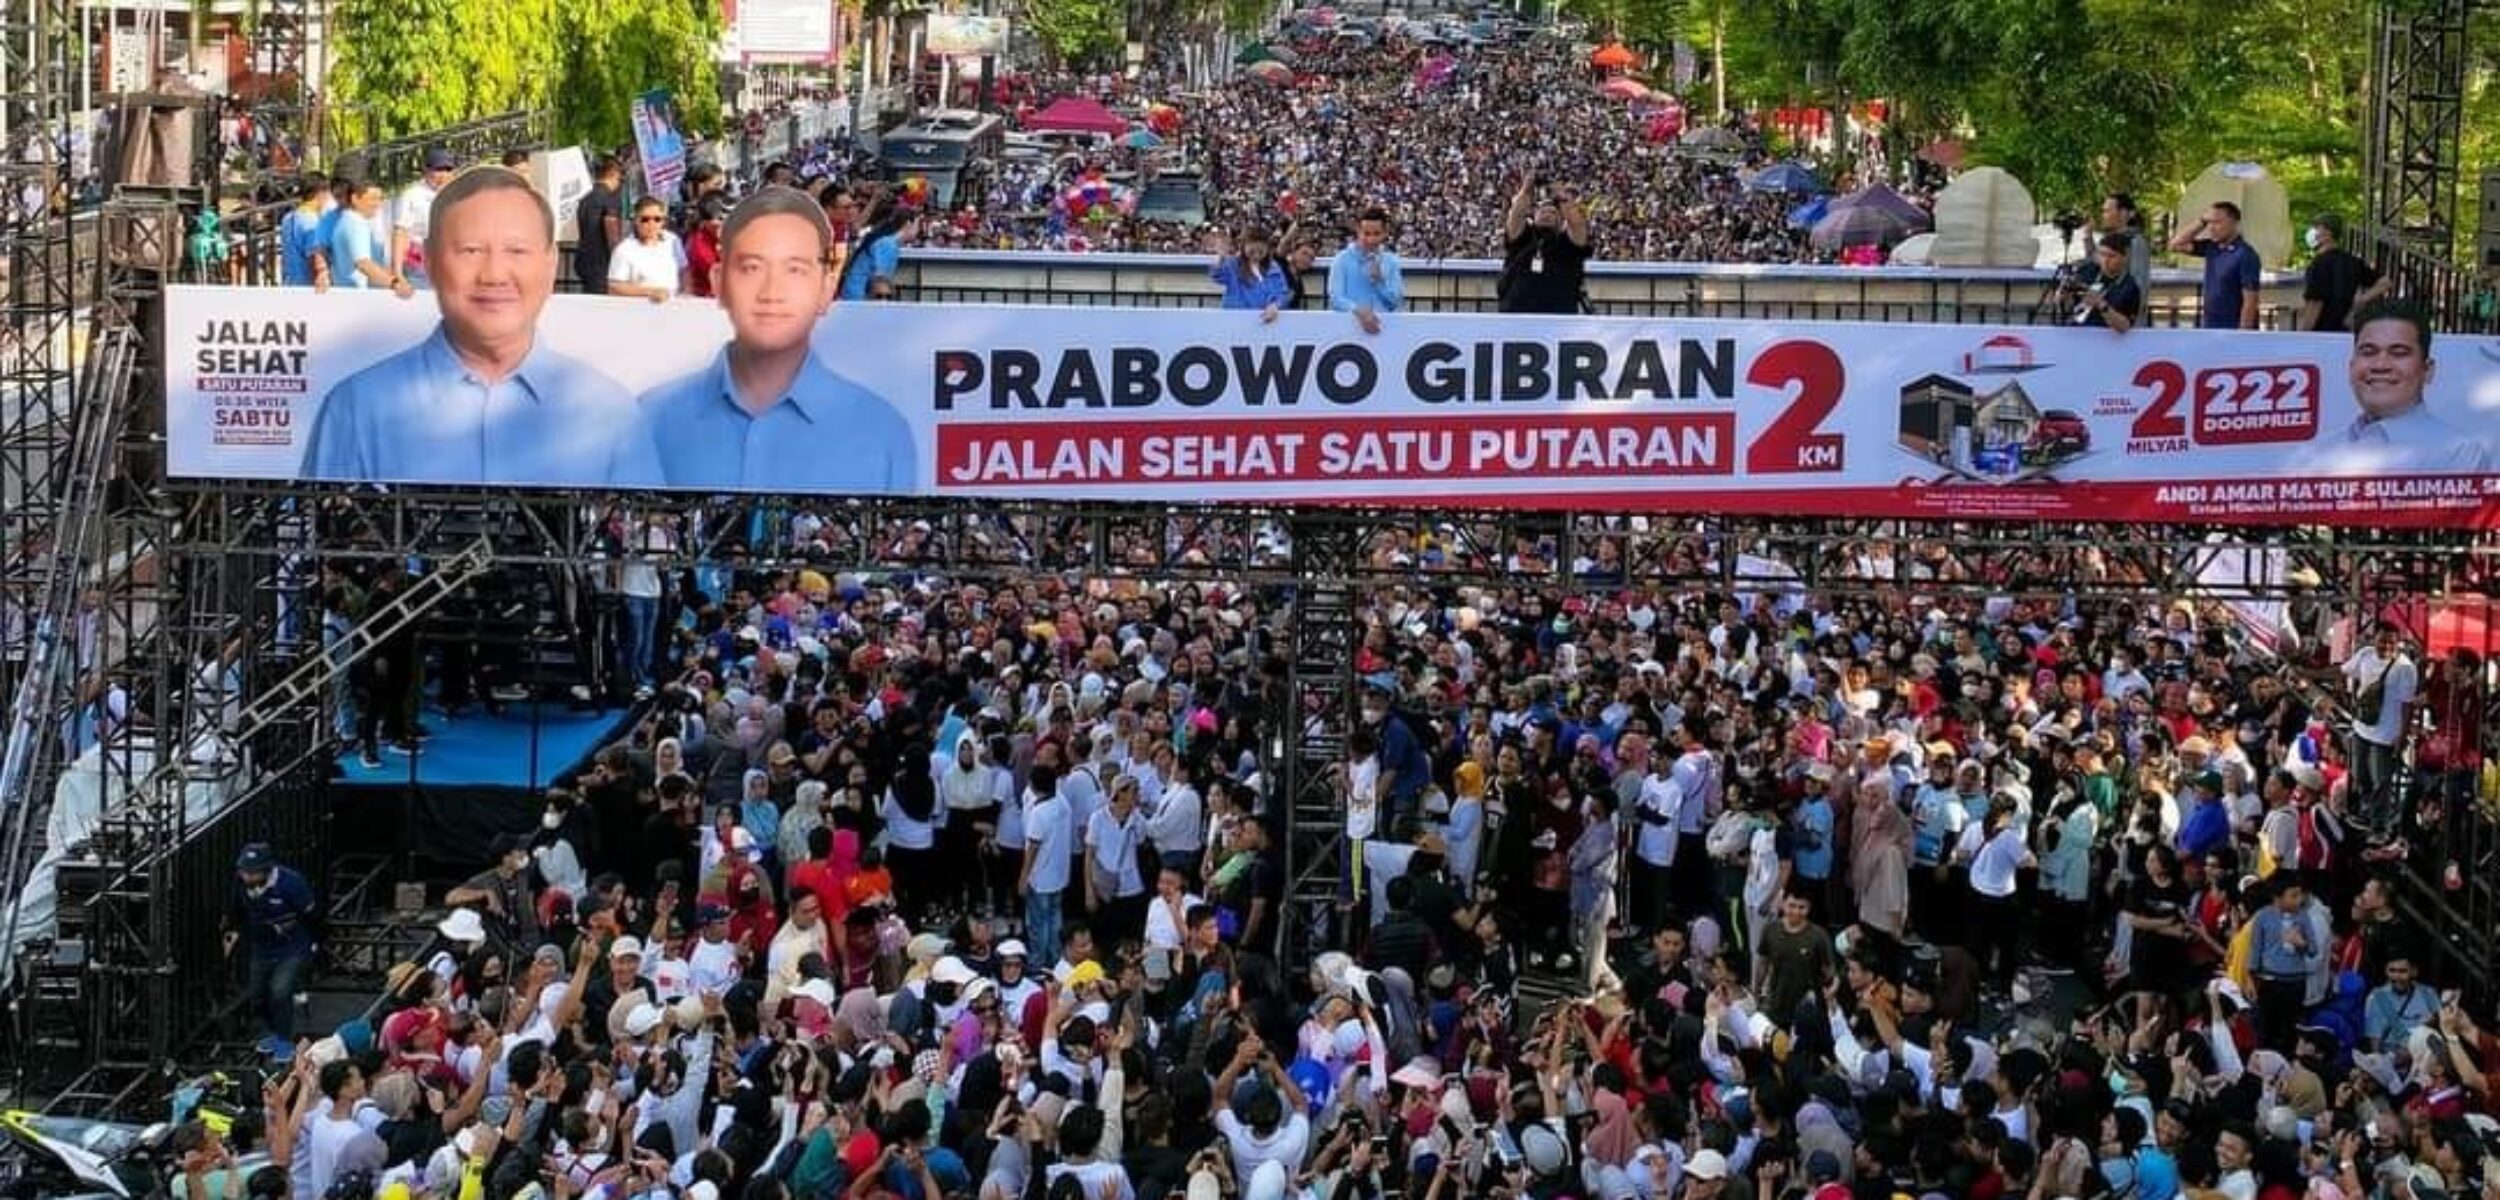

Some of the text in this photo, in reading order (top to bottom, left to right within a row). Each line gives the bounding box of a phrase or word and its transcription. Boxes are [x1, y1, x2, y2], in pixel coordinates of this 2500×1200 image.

[197, 320, 306, 345] JALAN
[197, 349, 307, 375] SEHAT
[934, 338, 1736, 410] PRABOWO GIBRAN
[2131, 360, 2187, 438] 2
[2204, 368, 2310, 413] 222
[215, 410, 290, 427] SABTU
[1746, 340, 1845, 474] 2
[2203, 412, 2312, 431] DOORPRIZE
[951, 426, 1717, 481] JALAN SEHAT SATU PUTARAN
[1798, 446, 1837, 464] KM
[2126, 439, 2189, 454] MILYAR
[2156, 485, 2207, 502] ANDI
[2212, 484, 2275, 501] AMAR
[2279, 482, 2359, 499] MA'RUF
